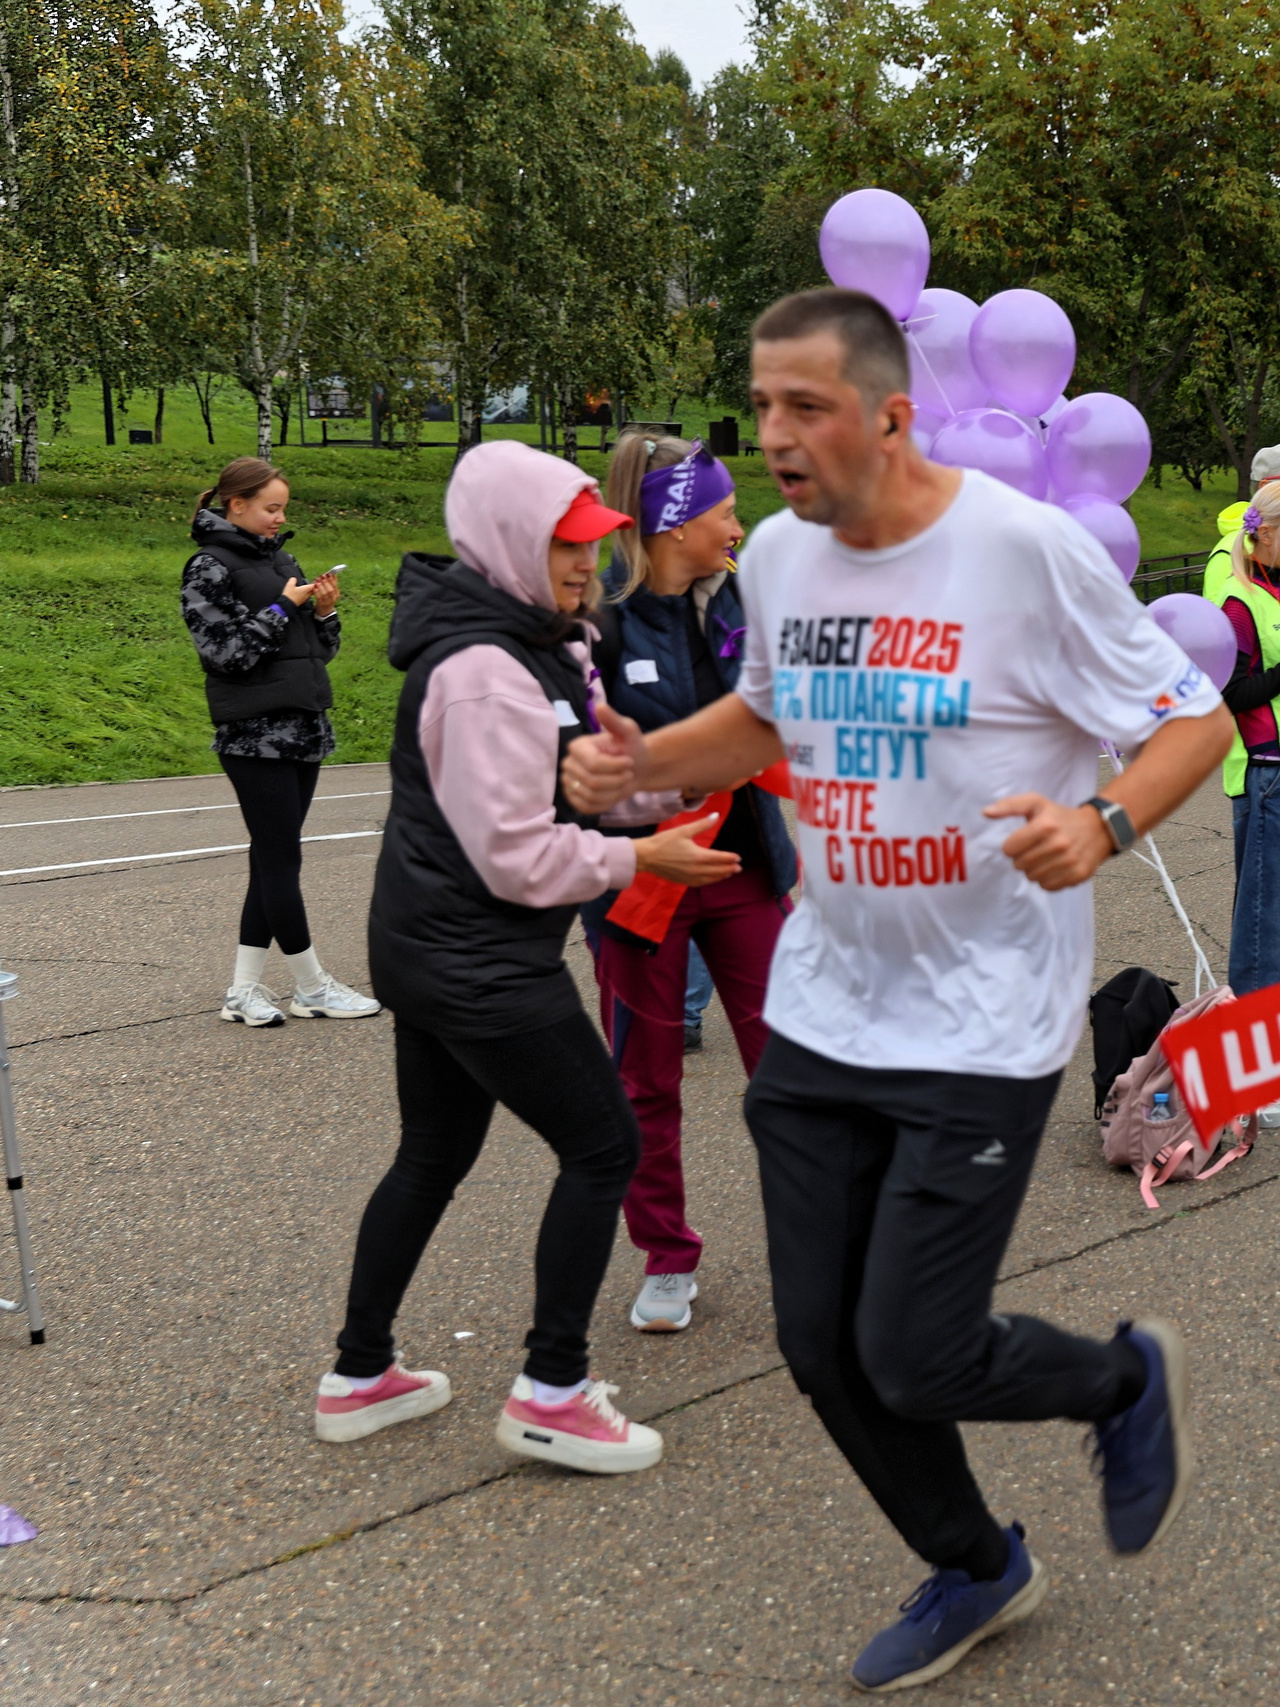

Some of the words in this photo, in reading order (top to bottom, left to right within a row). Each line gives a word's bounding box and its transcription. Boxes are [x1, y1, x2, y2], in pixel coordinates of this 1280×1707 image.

[809, 669, 972, 729] ПЛАНЕТЫ
[835, 726, 930, 780] БЕГУТ
[825, 833, 845, 884] С
[848, 826, 968, 889] ТОБОЙ
